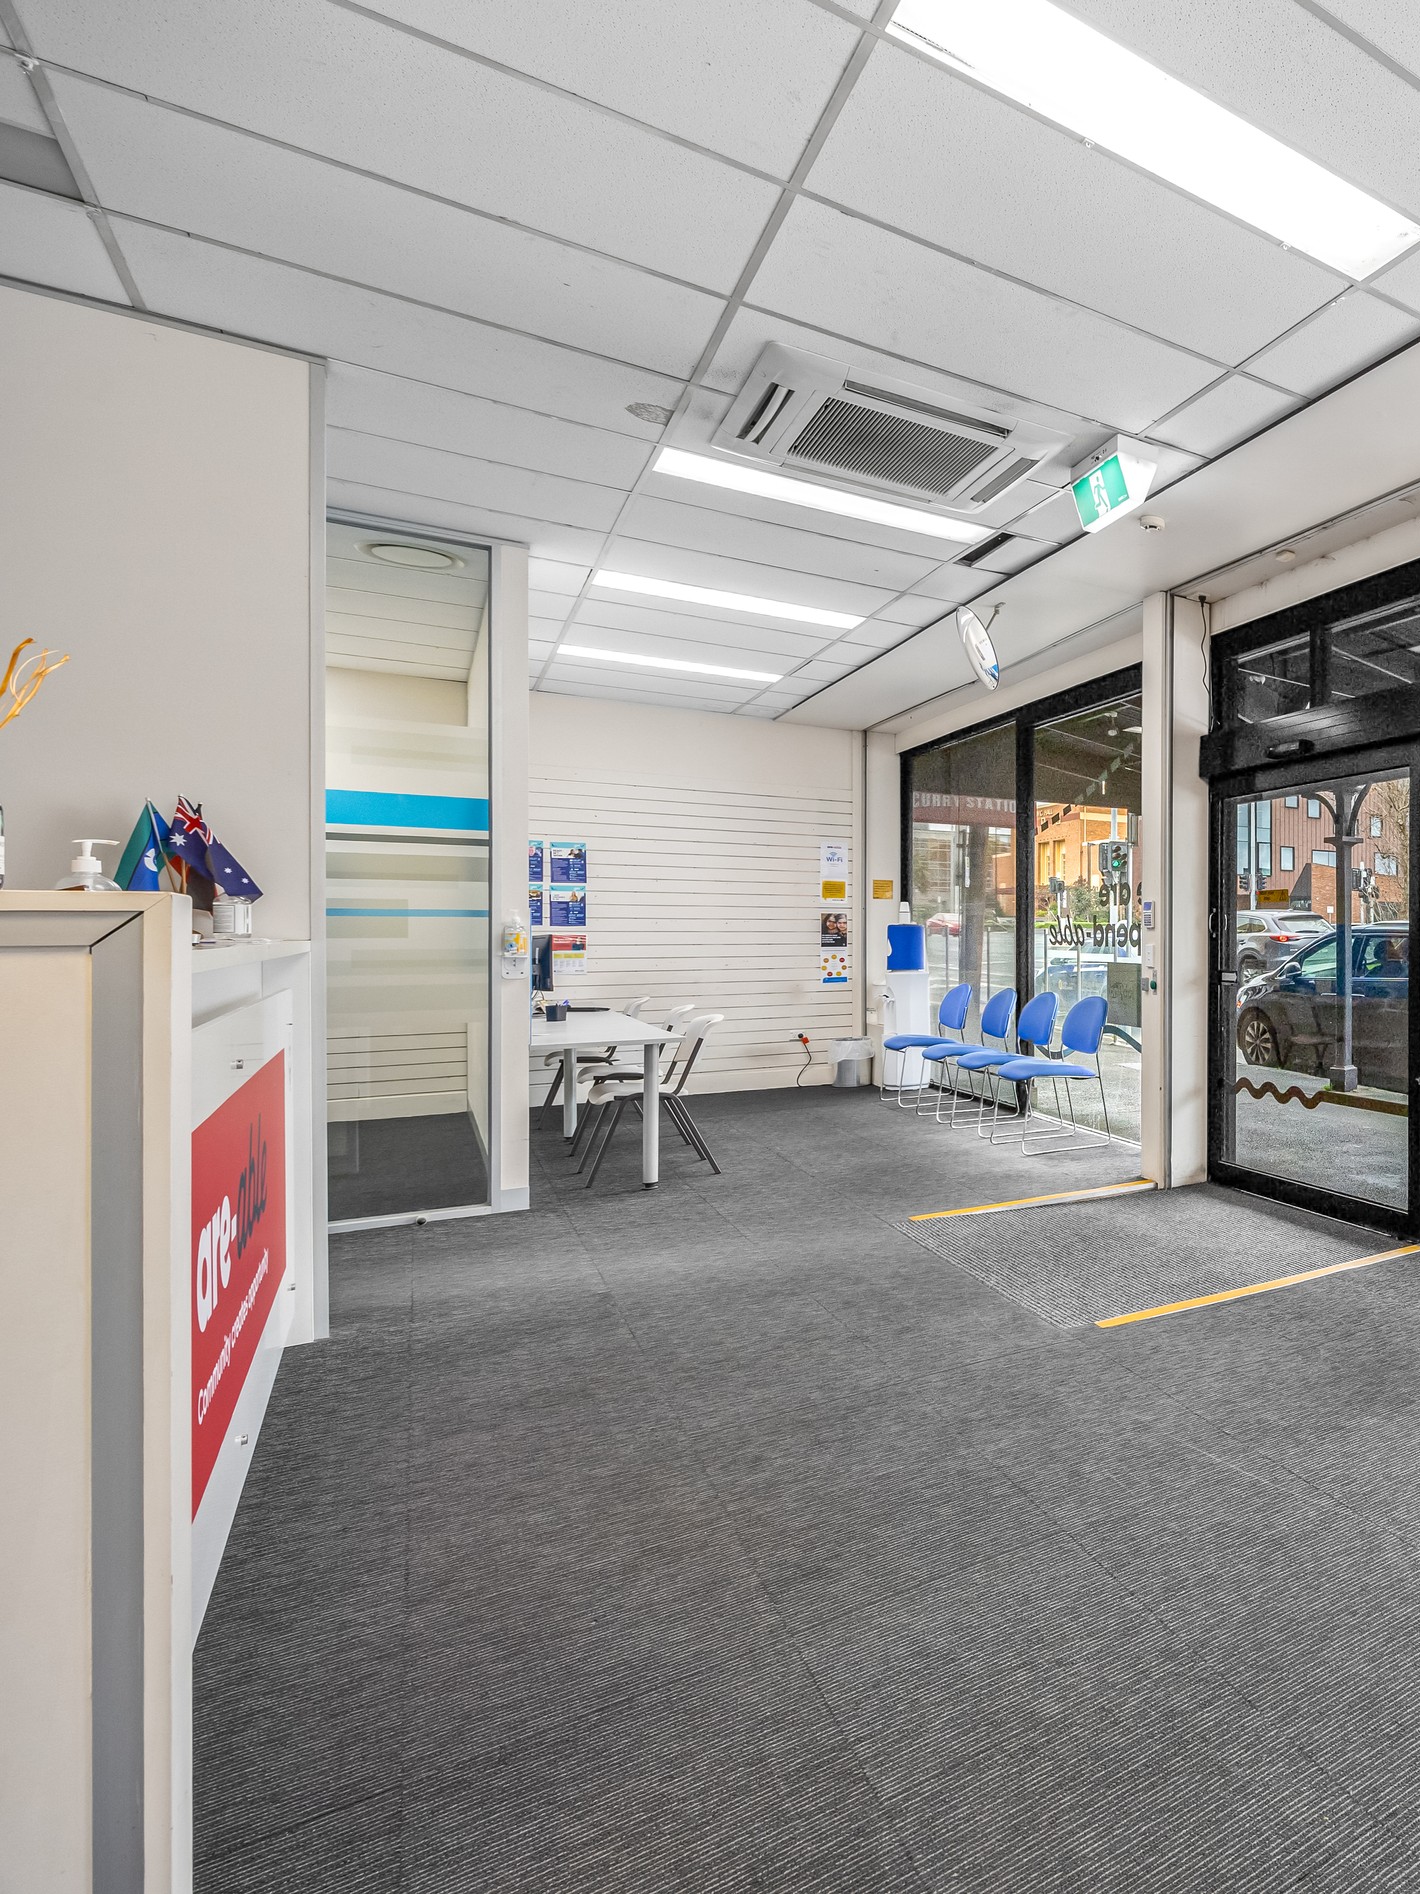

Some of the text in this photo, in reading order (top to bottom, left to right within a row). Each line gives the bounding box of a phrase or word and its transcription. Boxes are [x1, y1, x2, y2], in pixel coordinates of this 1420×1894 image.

[966, 797, 1016, 813] STATIO
[196, 1111, 268, 1333] are-able
[197, 1247, 269, 1425] Community creates opportunity
